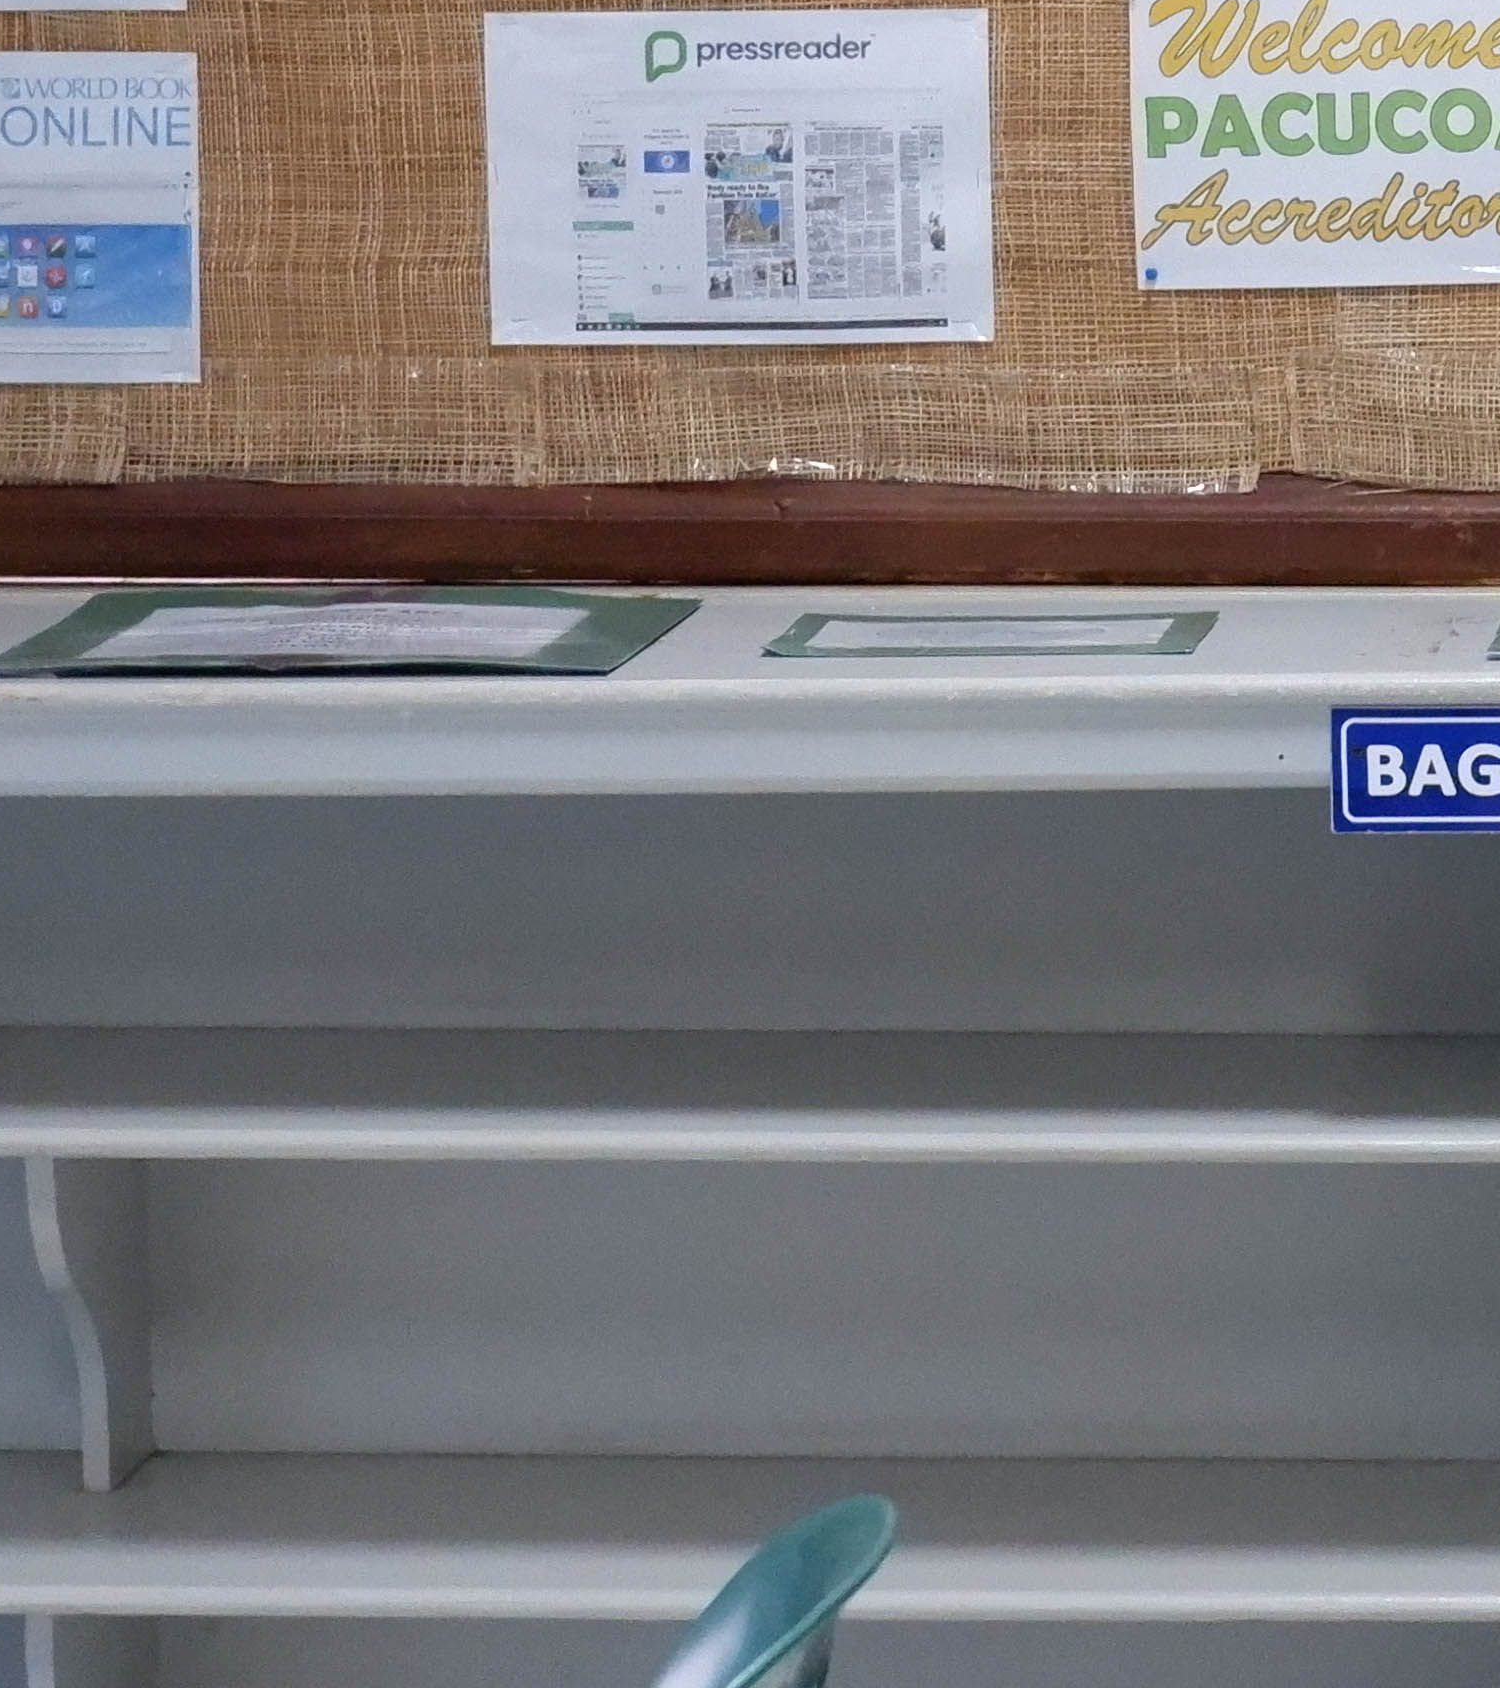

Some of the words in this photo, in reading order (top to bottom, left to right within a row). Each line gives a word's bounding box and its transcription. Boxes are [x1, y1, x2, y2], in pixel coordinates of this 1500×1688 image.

[697, 34, 872, 68] pressreader
[23, 78, 115, 100] WORLD
[125, 78, 191, 100] BOOK
[1, 106, 191, 147] ONLINE
